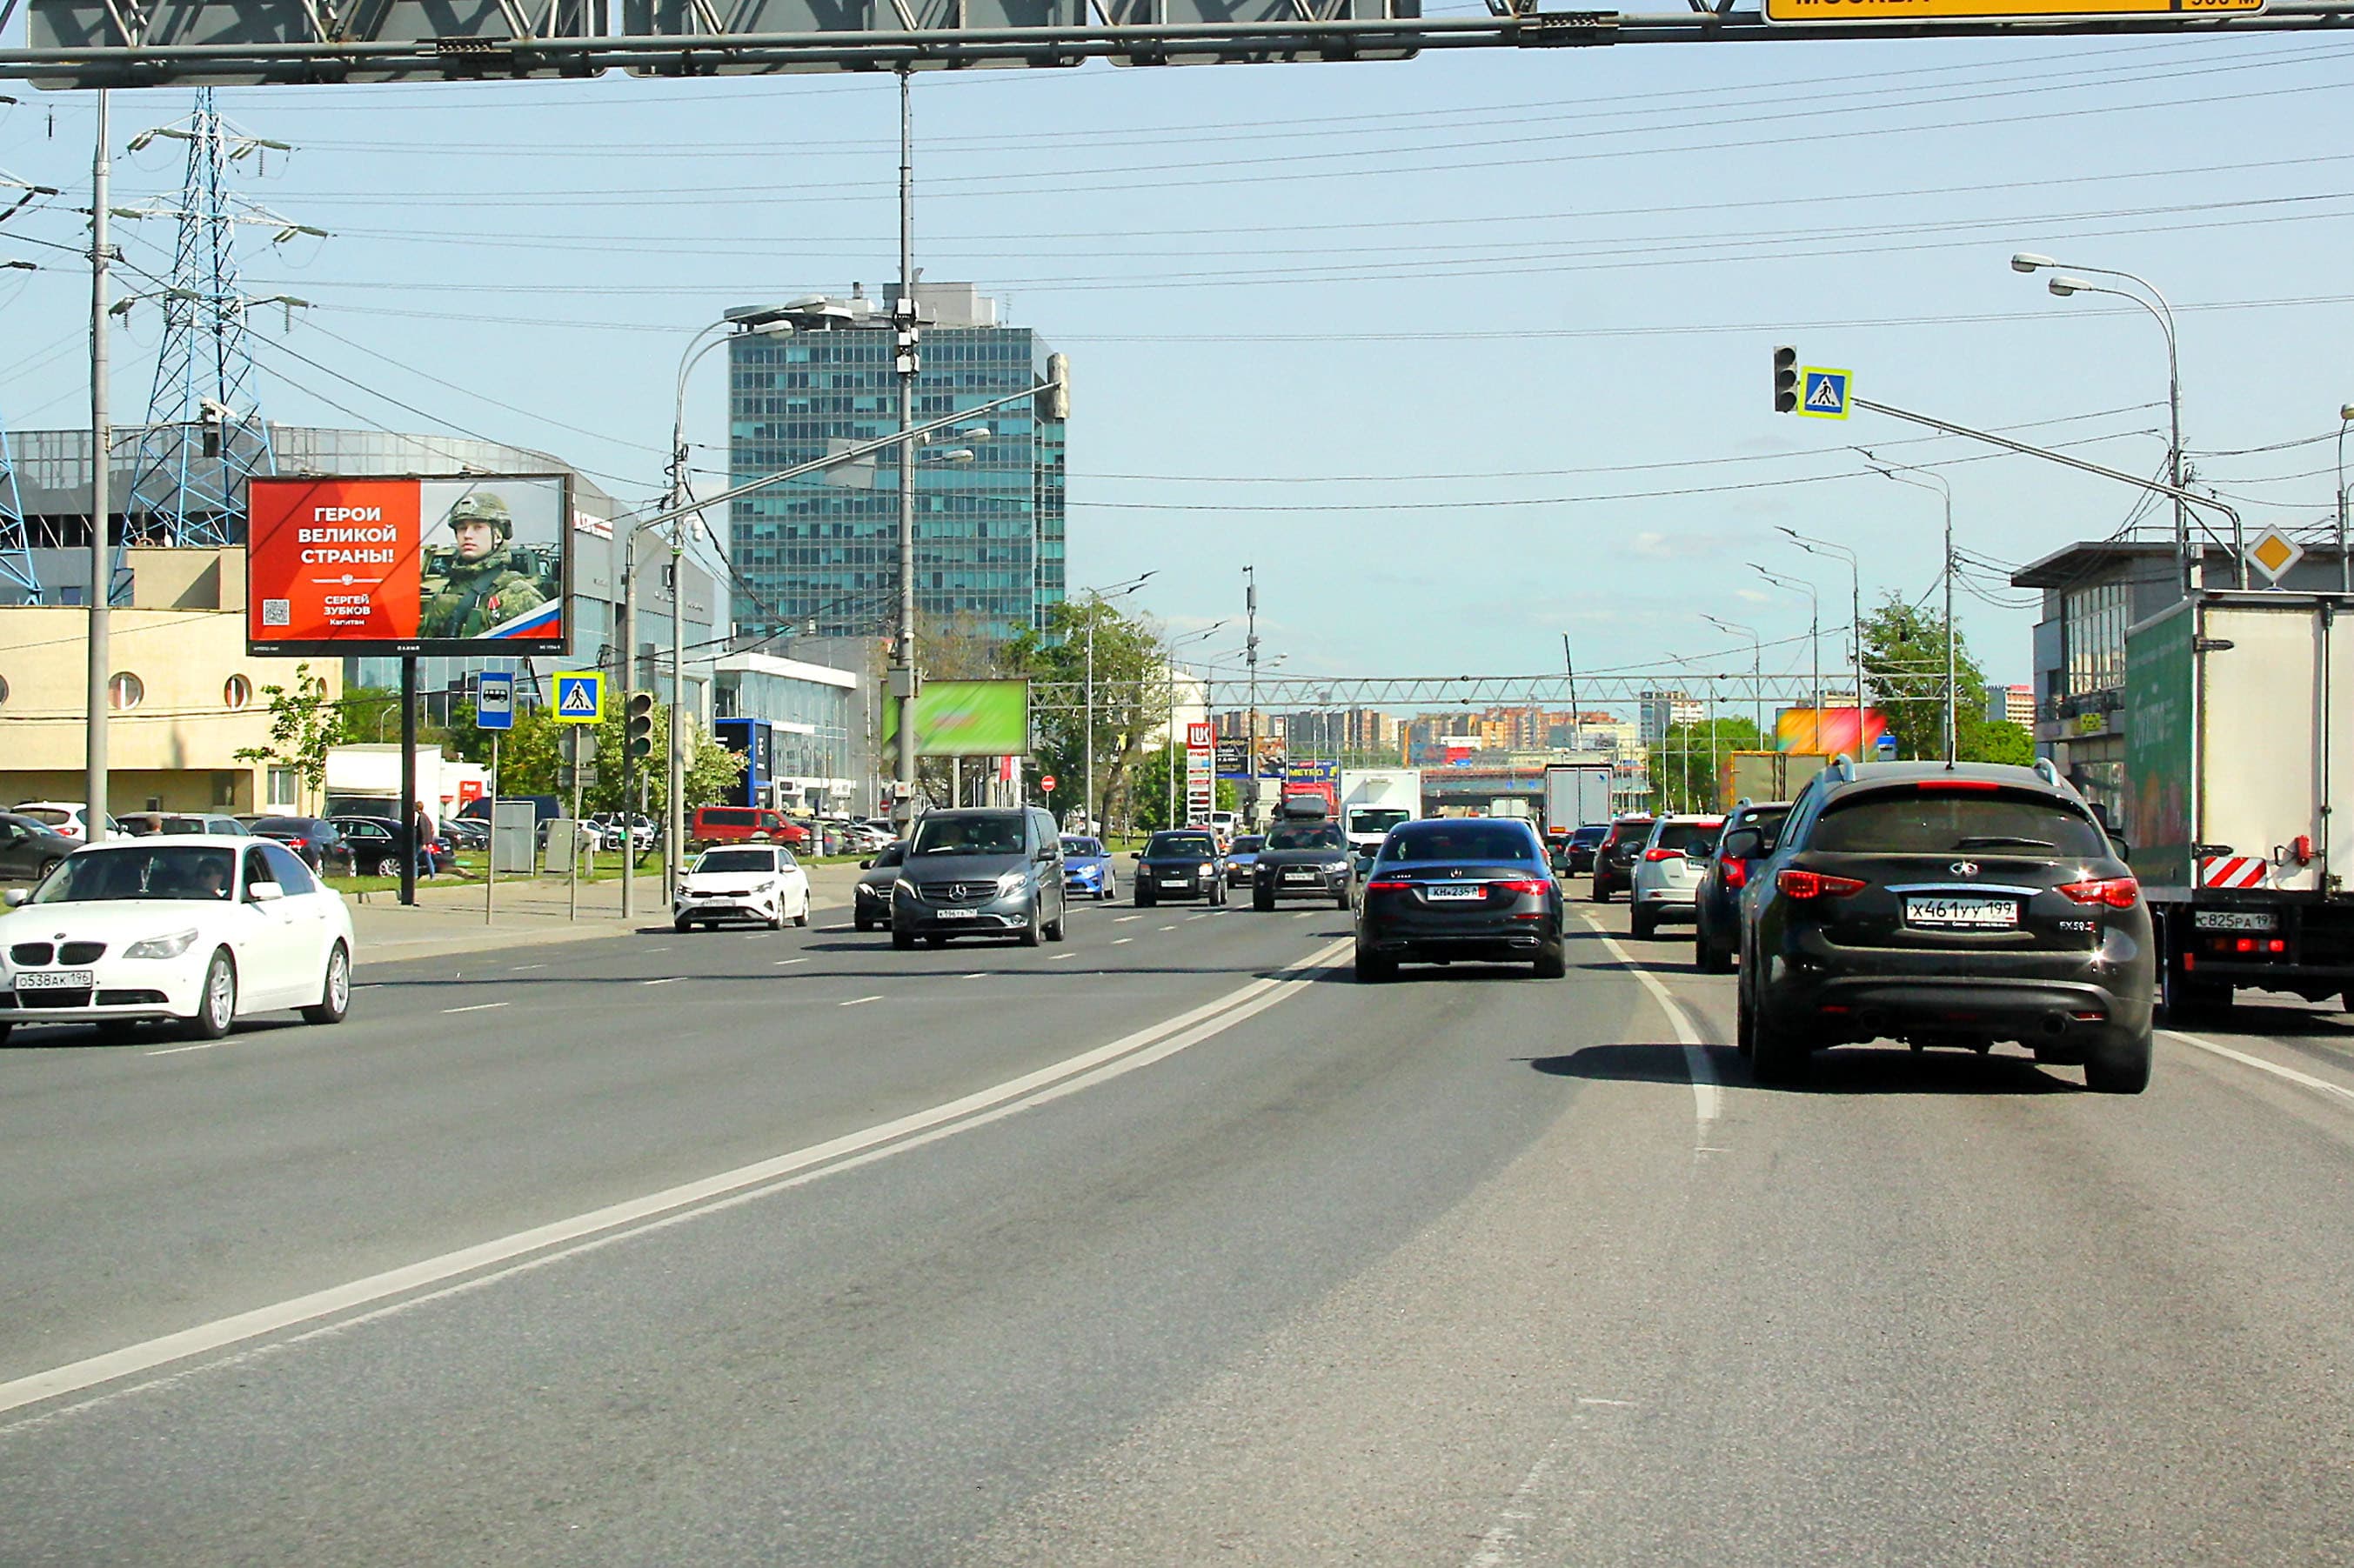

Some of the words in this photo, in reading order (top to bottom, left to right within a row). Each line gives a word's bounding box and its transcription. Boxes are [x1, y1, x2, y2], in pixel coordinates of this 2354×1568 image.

[314, 507, 381, 522] ГЕРОИ
[298, 524, 397, 543] ВЕЛИКОЙ
[300, 549, 394, 564] СТРАНЫ!
[324, 593, 370, 604] СЕРГЕЙ
[323, 606, 371, 615] ЗУБКОВ
[1288, 768, 1324, 777] METRO
[1985, 902, 2012, 915] 199
[70, 973, 90, 983] 196
